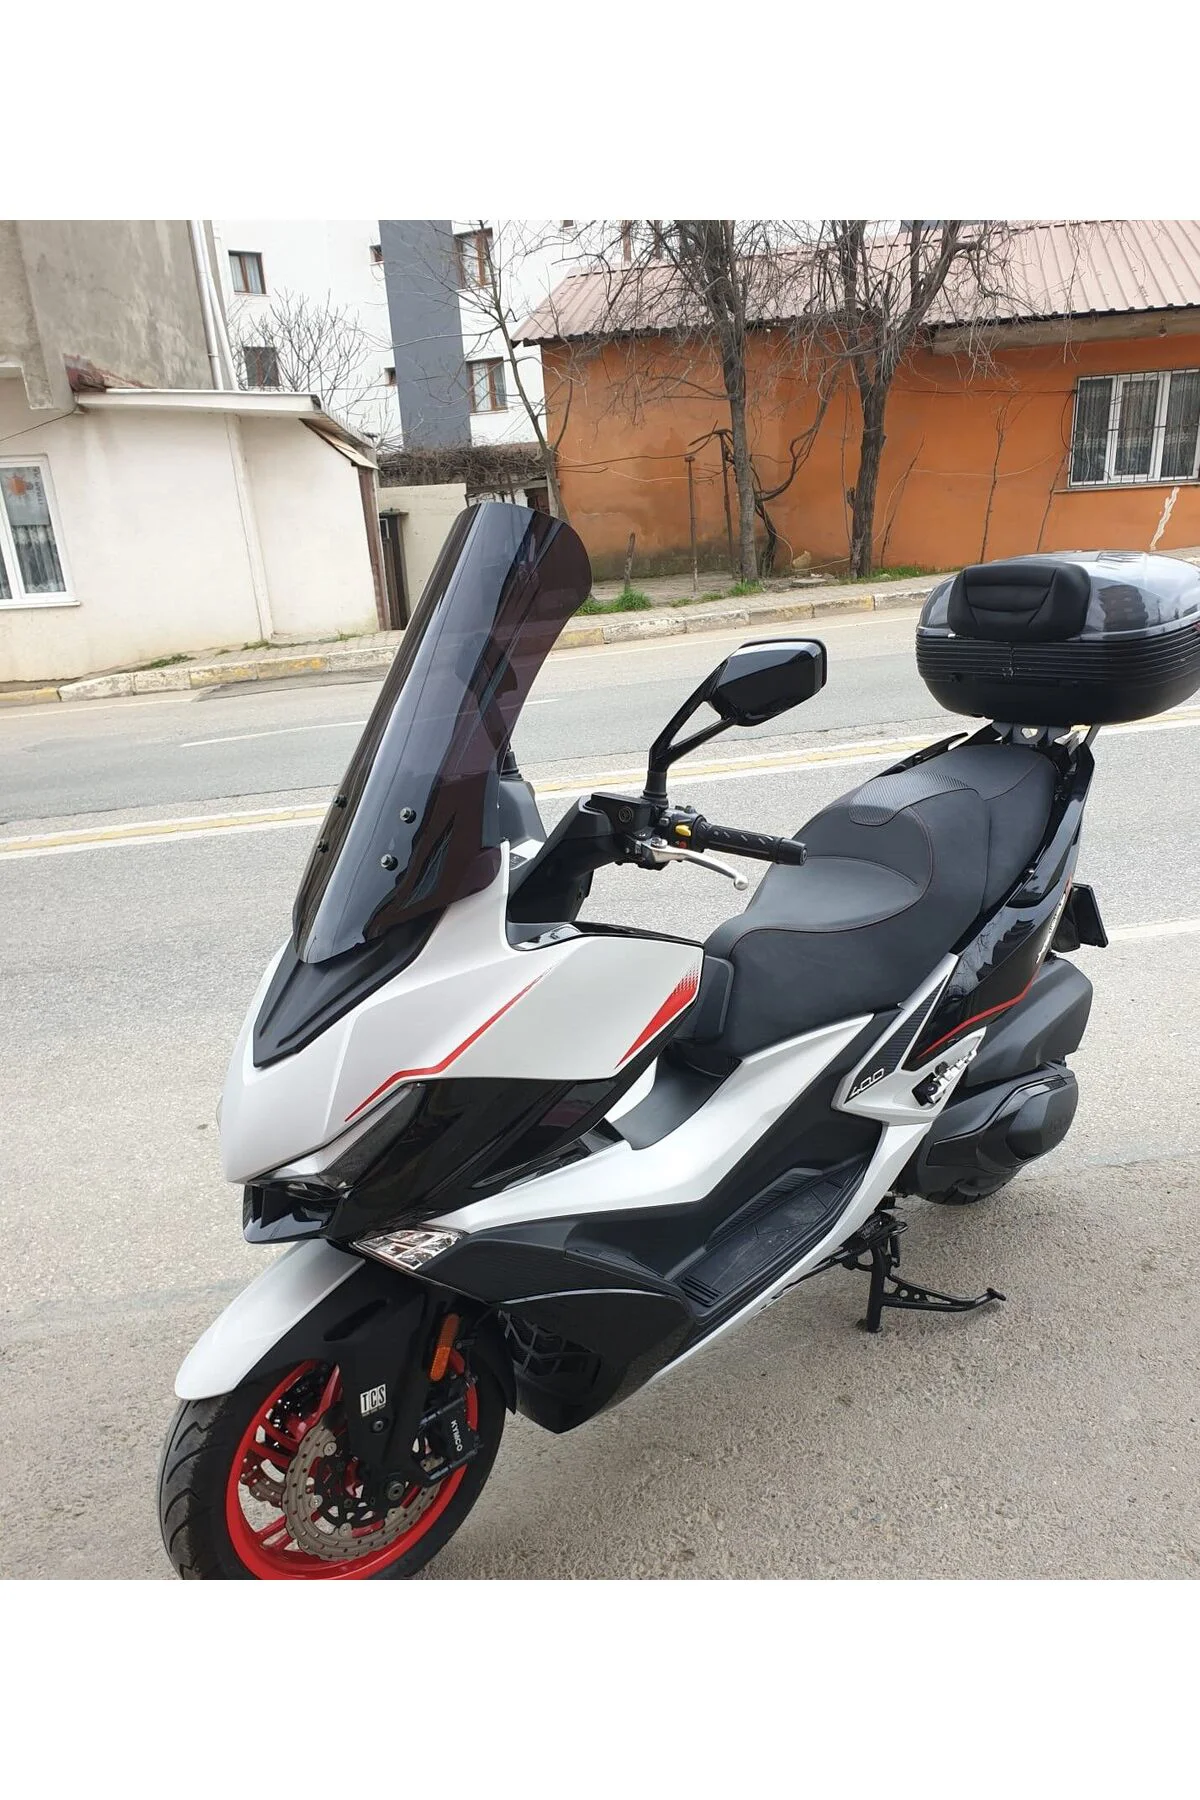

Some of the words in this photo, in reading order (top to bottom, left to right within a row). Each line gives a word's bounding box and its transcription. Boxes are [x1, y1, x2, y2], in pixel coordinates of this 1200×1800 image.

[849, 1068, 885, 1099] 400
[361, 1385, 386, 1412] TCS
[450, 1419, 463, 1452] KYMCO
